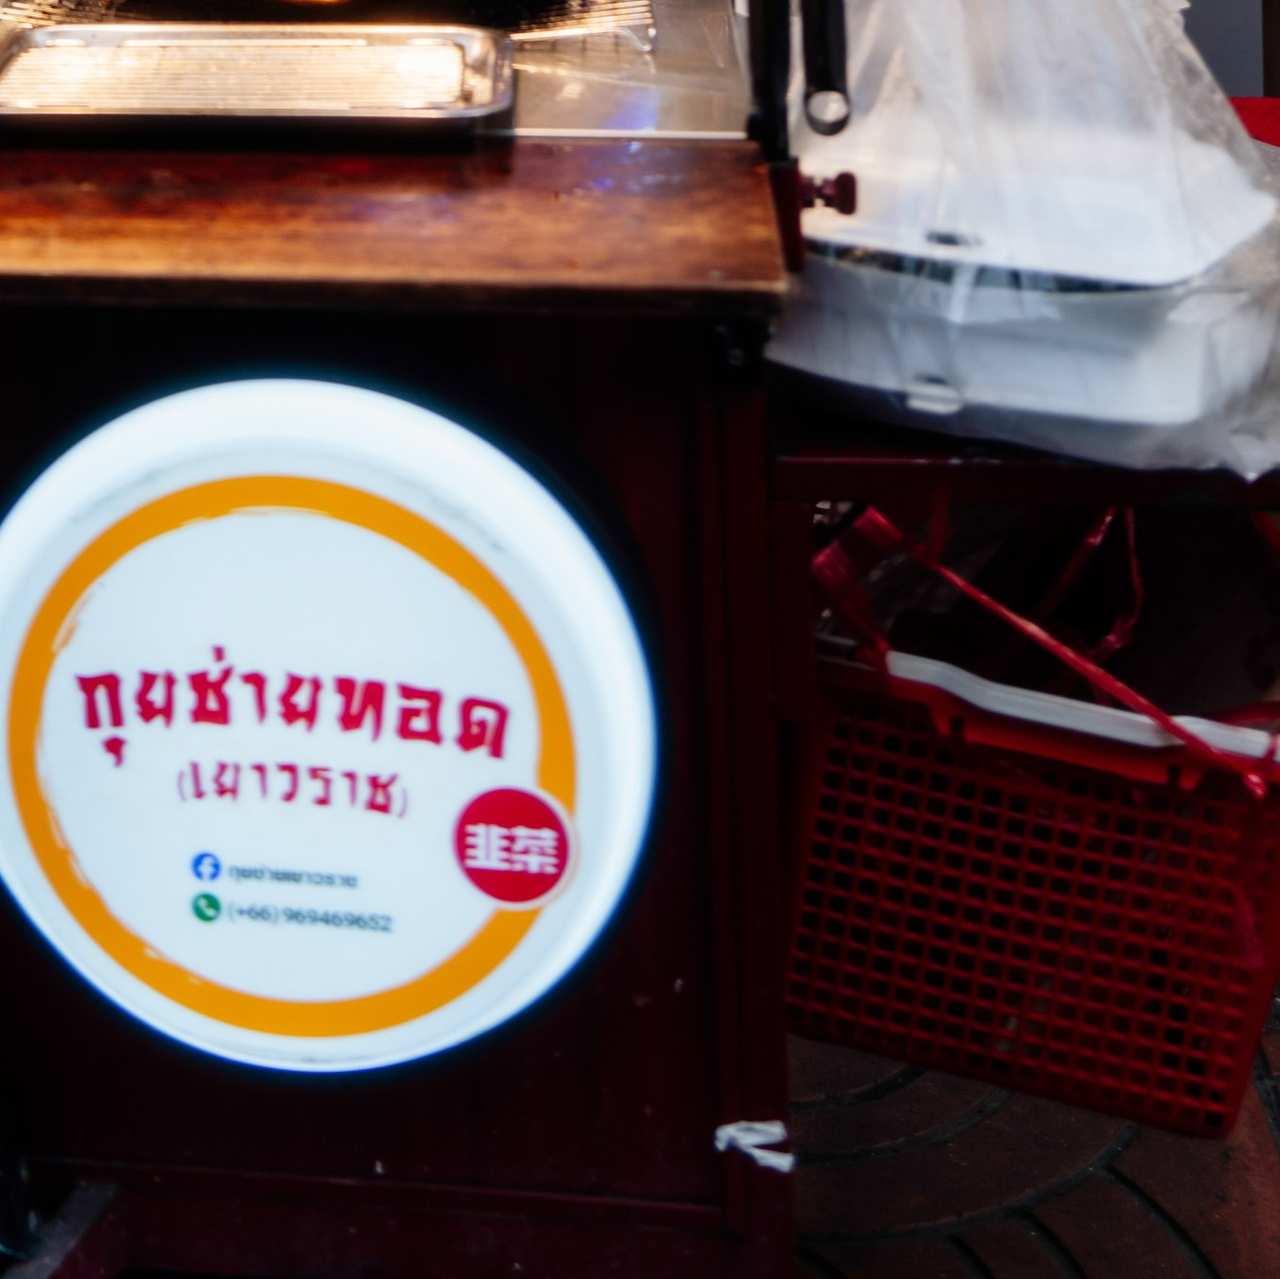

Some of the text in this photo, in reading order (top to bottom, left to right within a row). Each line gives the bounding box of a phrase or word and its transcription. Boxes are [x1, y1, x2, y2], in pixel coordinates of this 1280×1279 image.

[76, 647, 509, 766] กุยช่ายทอด
[178, 761, 408, 818] (เยาวราช)
[464, 822, 559, 874] 韭菜
